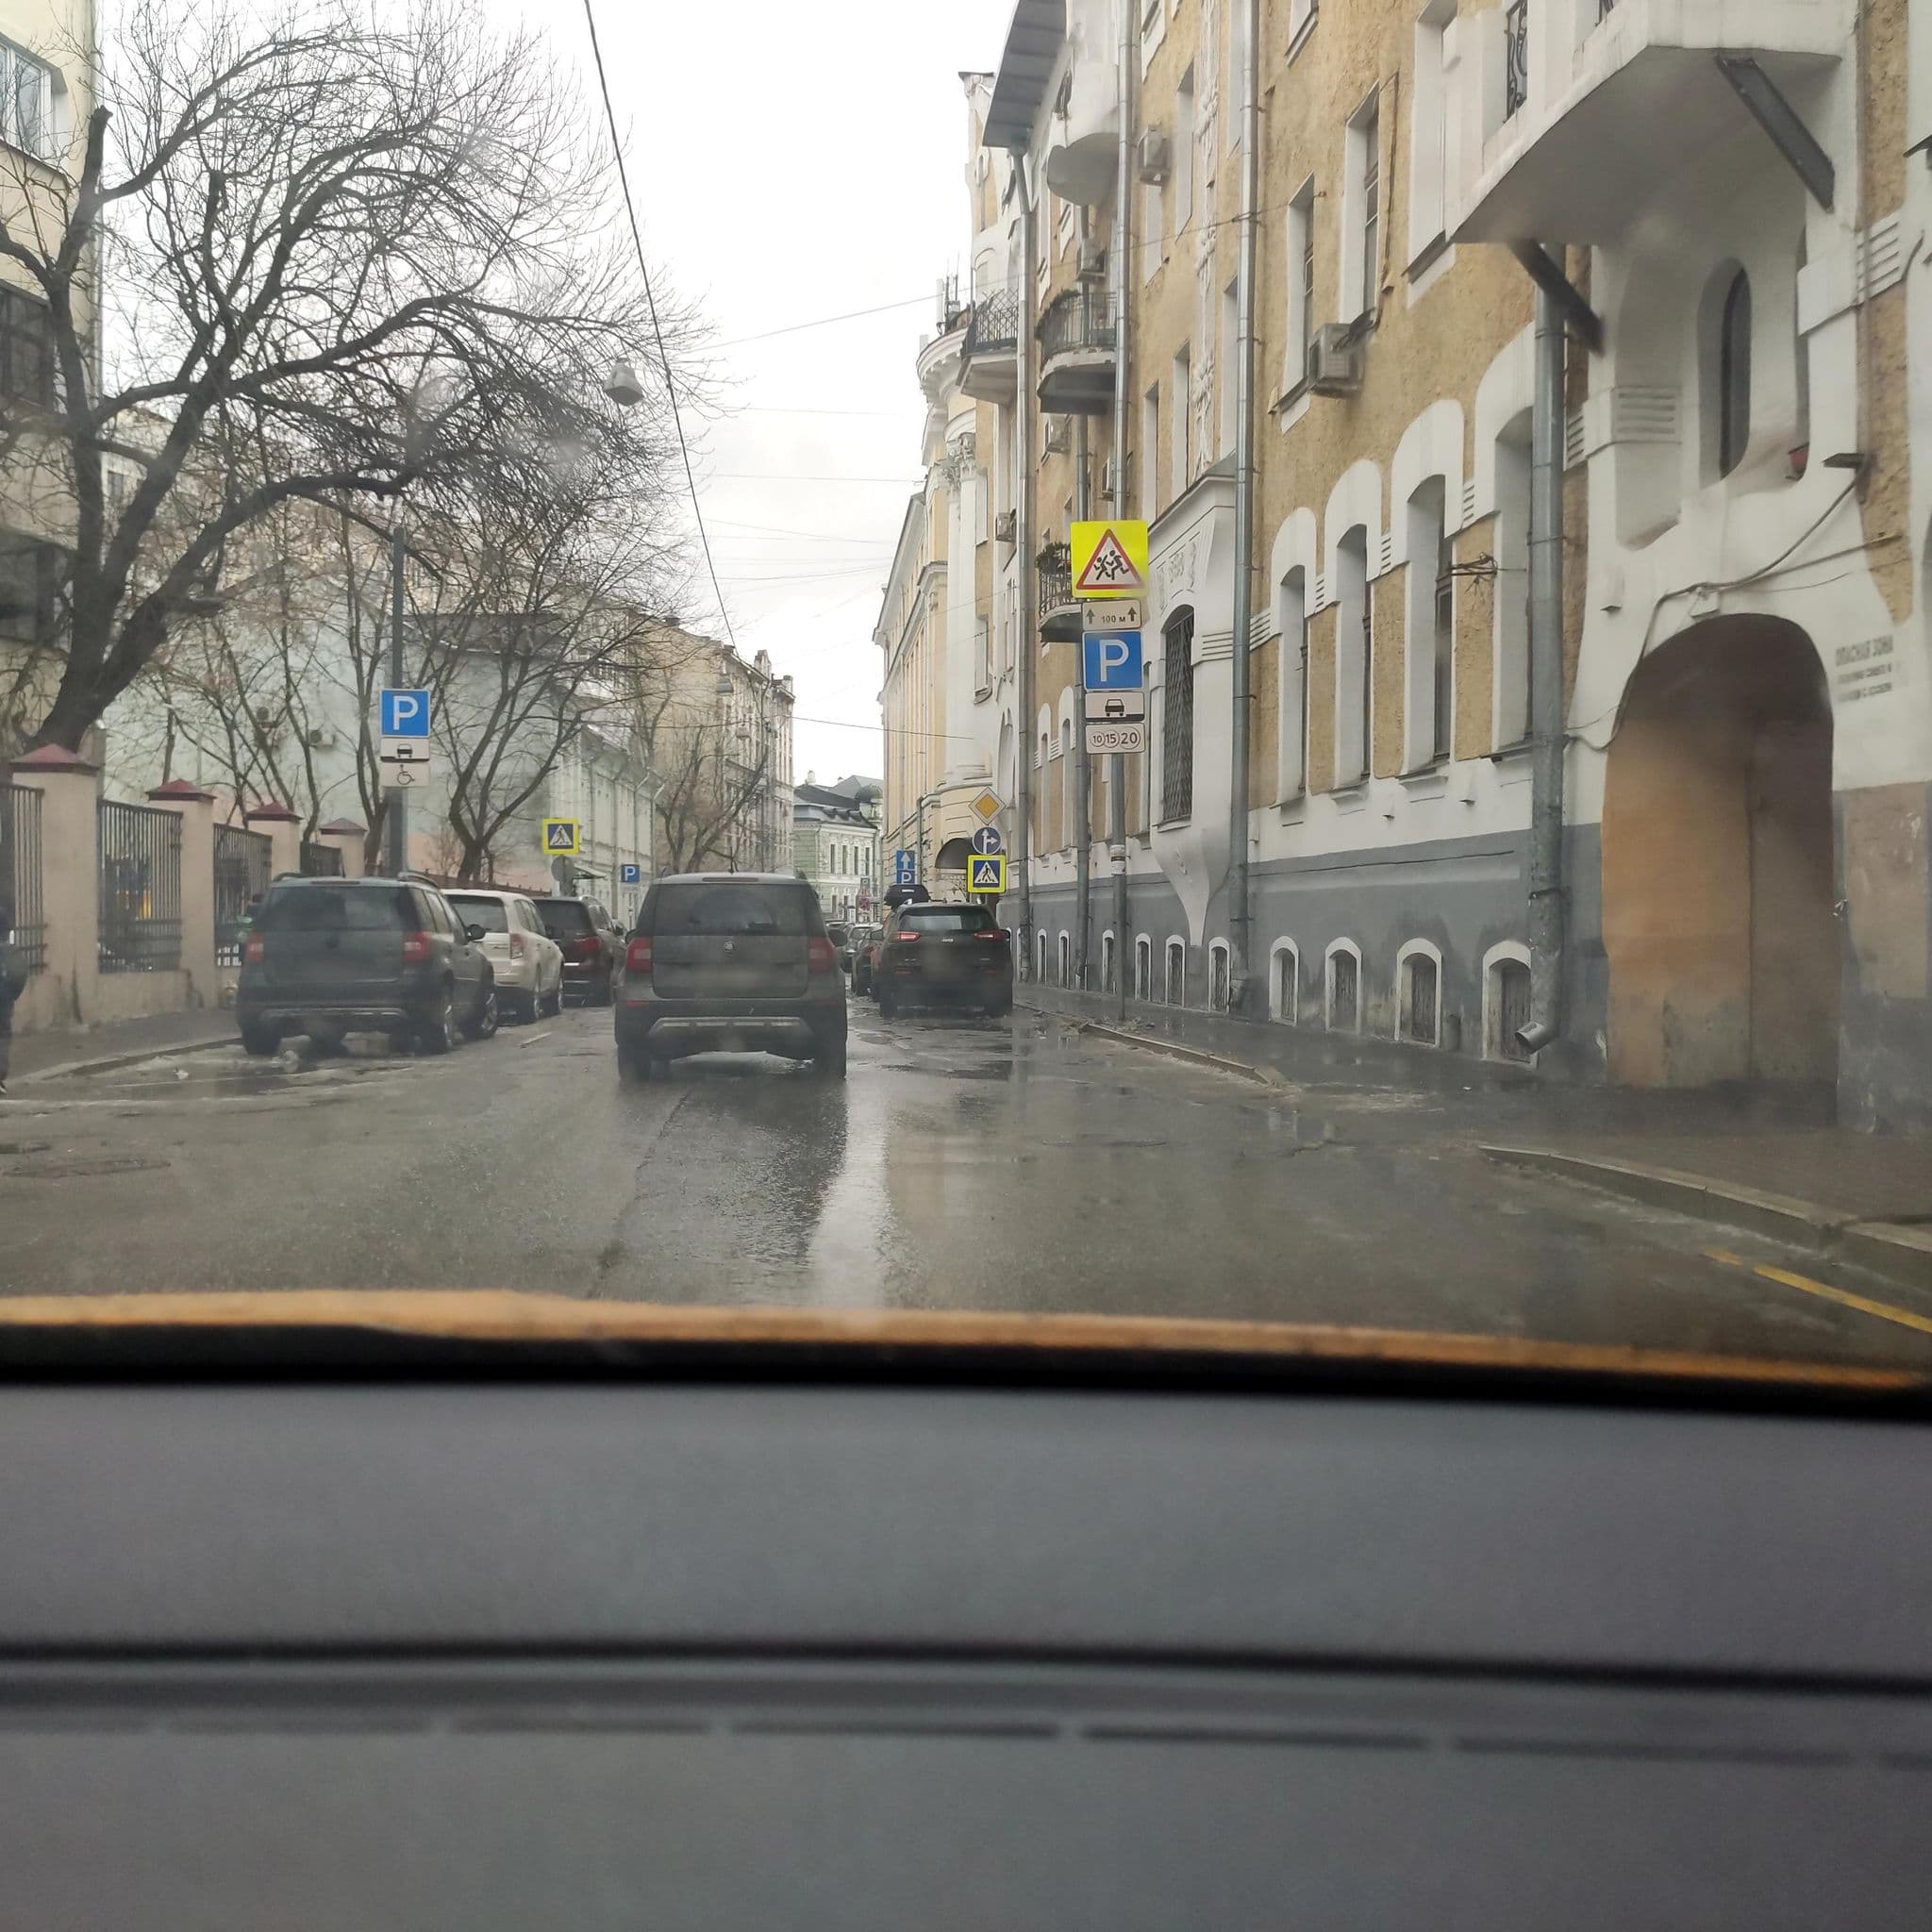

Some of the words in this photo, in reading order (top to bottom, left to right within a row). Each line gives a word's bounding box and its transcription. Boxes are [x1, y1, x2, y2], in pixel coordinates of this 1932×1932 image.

[1102, 615, 1117, 624] 100
[1099, 639, 1129, 682] P
[393, 695, 419, 730] P
[1092, 735, 1103, 743] 10
[1106, 733, 1117, 744] 15
[1121, 732, 1138, 744] 20
[625, 866, 636, 881] P
[901, 872, 912, 884] P
